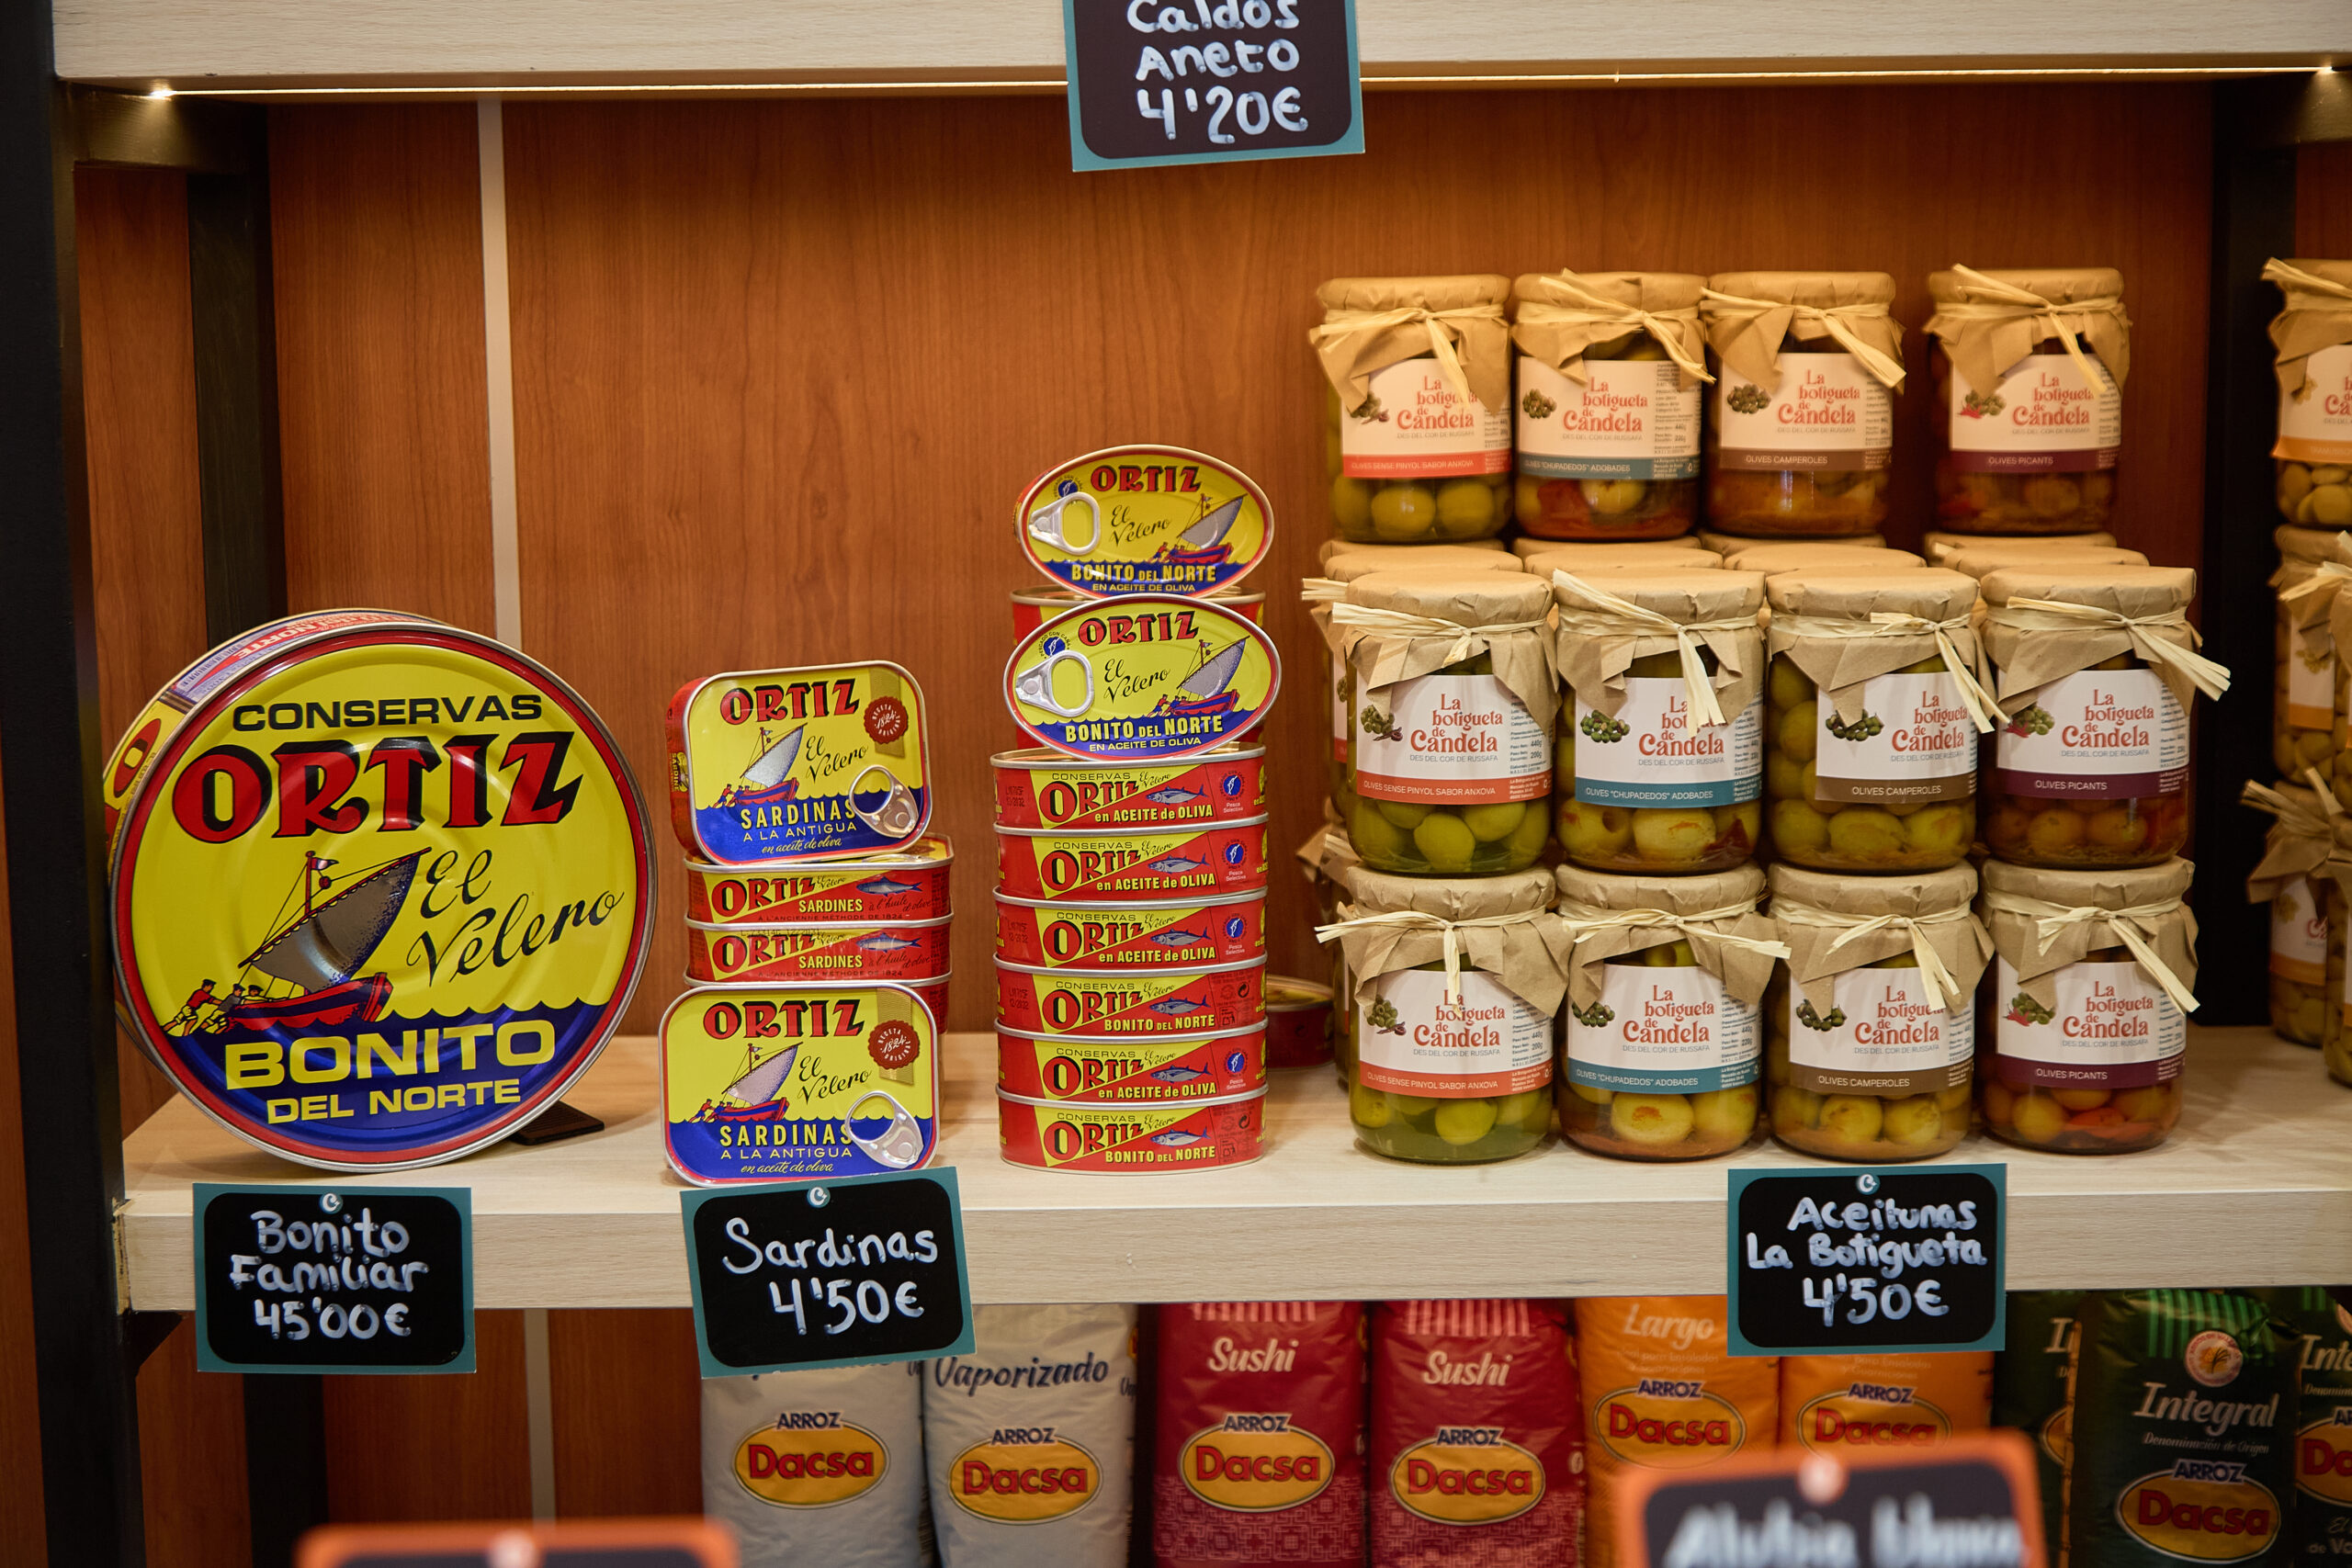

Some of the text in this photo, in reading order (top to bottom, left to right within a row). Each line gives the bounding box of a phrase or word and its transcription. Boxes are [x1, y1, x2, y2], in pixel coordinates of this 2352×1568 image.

[1127, 0, 1300, 33] Caldos
[1136, 39, 1300, 82] Aneto
[1136, 86, 1309, 144] 4'20€
[1590, 377, 1609, 392] La
[1806, 369, 1825, 386] La
[1583, 393, 1648, 411] botigueta
[1799, 386, 1860, 404] botigueta
[1799, 400, 1812, 411] de
[1563, 410, 1643, 432] Candela
[1582, 407, 1595, 417] de
[1778, 402, 1857, 425] Candela
[1745, 455, 1828, 465] OLIVES CAMPEROLES
[1091, 466, 1202, 492] ORTIZ
[1112, 505, 1128, 526] El
[1110, 518, 1171, 547] Velero
[1071, 564, 1216, 582] BONITO DEL NORTE
[1165, 584, 1195, 592] OLIVA
[1078, 611, 1199, 647] ORTIZ
[1105, 659, 1125, 682] El
[1104, 669, 1170, 704] Velero
[2094, 689, 2114, 705] La
[720, 678, 859, 726] ORTIZ
[1441, 694, 1461, 710] La
[1922, 691, 1939, 707] La
[232, 694, 542, 732] CONSERVAS
[1432, 710, 1503, 731] botigueta
[1914, 706, 1968, 727] botigueta
[2085, 705, 2154, 726] botigueta
[1066, 715, 1224, 743] BONITO DEL NORTE
[1432, 727, 1445, 737] de
[1914, 726, 1926, 736] de
[2062, 725, 2150, 748] Candela
[2085, 722, 2098, 732] de
[806, 736, 825, 761] El
[1107, 741, 1148, 750] ACEITE
[1169, 738, 1202, 747] OLIVA
[1410, 729, 1498, 753] Candela
[1639, 733, 1724, 756] Candela
[1892, 727, 1964, 751] Candela
[807, 745, 869, 783] Velero
[1467, 754, 1498, 762] RUSSAFA
[171, 731, 584, 844] ORTIZ
[1052, 773, 1131, 781] CONSERVAS
[1363, 781, 1383, 791] OLIVES
[1384, 784, 1406, 794] SENSE
[1407, 786, 1435, 795] PINYOL
[1464, 787, 1496, 795] ANXOVA
[2035, 780, 2108, 791] OLIVES PICANTS
[1039, 780, 1138, 823] ORTIZ
[1586, 787, 1609, 797] OLIVES
[1672, 791, 1713, 799] ADOBADES
[1851, 785, 1941, 796] OLIVES CAMPEROLES
[741, 797, 855, 829] SARDINAS
[1094, 805, 1214, 822] en ACEITE de OLIVA
[743, 822, 857, 842] A LA ANTIGUA
[419, 849, 494, 919] El
[711, 876, 816, 918] ORTIZ
[797, 898, 864, 913] SARDINES
[406, 891, 625, 989] Velero
[711, 934, 816, 974] ORTIZ
[797, 954, 864, 969] SARDINES
[1056, 981, 1136, 990] CONSERVAS
[703, 999, 865, 1040] ORTIZ
[1042, 988, 1143, 1030] ORTIZ
[1104, 1015, 1215, 1032] BONITO DEL NORTE
[225, 1020, 556, 1091] BONITO
[1057, 1048, 1136, 1057] CONSERVAS
[798, 1056, 822, 1082] El
[1043, 1055, 1144, 1097] ORTIZ
[1577, 1068, 1597, 1080] OLIVES
[1656, 1078, 1698, 1087] ADOBADES
[2035, 1068, 2108, 1079] OLIVES PICANTS
[797, 1069, 871, 1105] Velero
[1098, 1083, 1216, 1099] en ACEITE de OLIVA
[267, 1078, 521, 1125] DEL NORTE
[1057, 1112, 1136, 1122] CONSERVAS
[719, 1124, 852, 1146] SARDINAS
[1043, 1120, 1144, 1161] ORTIZ
[720, 1147, 852, 1159] A LA ANTIGUA
[1105, 1146, 1216, 1163] BONITO DEL NORTE
[741, 1160, 834, 1174] en aceite de oliva
[1787, 1197, 1978, 1231] Aceitunas
[251, 1208, 410, 1258] Bonito
[722, 1217, 938, 1274] Sardinas
[1747, 1232, 1988, 1280] La Botigueta
[230, 1253, 430, 1293] Familiar
[769, 1277, 924, 1336] 4'50€
[1802, 1273, 1951, 1327] 4'50€
[254, 1297, 412, 1340] 45'00€
[1623, 1303, 1714, 1350] Largo
[1207, 1337, 1299, 1373] Sushi
[934, 1352, 1108, 1396] Vaporizado
[1422, 1350, 1514, 1386] Sushi
[1637, 1381, 1702, 1398] ARROZ
[1849, 1383, 1914, 1404] ARROZ
[776, 1412, 841, 1430] ARROZ
[2132, 1382, 2280, 1437] Integral
[1223, 1415, 1287, 1432] ARROZ
[1610, 1404, 1731, 1446] Dacsa
[991, 1427, 1055, 1445] ARROZ
[1436, 1429, 1501, 1446] ARROZ
[2223, 1440, 2236, 1452] de
[748, 1445, 875, 1480] Dacsa
[1196, 1447, 1320, 1482] Dacsa
[2174, 1461, 2245, 1483] ARROZ
[963, 1461, 1088, 1495] Dacsa
[1408, 1460, 1532, 1495] Dacsa
[2139, 1489, 2270, 1536] Dacsa
